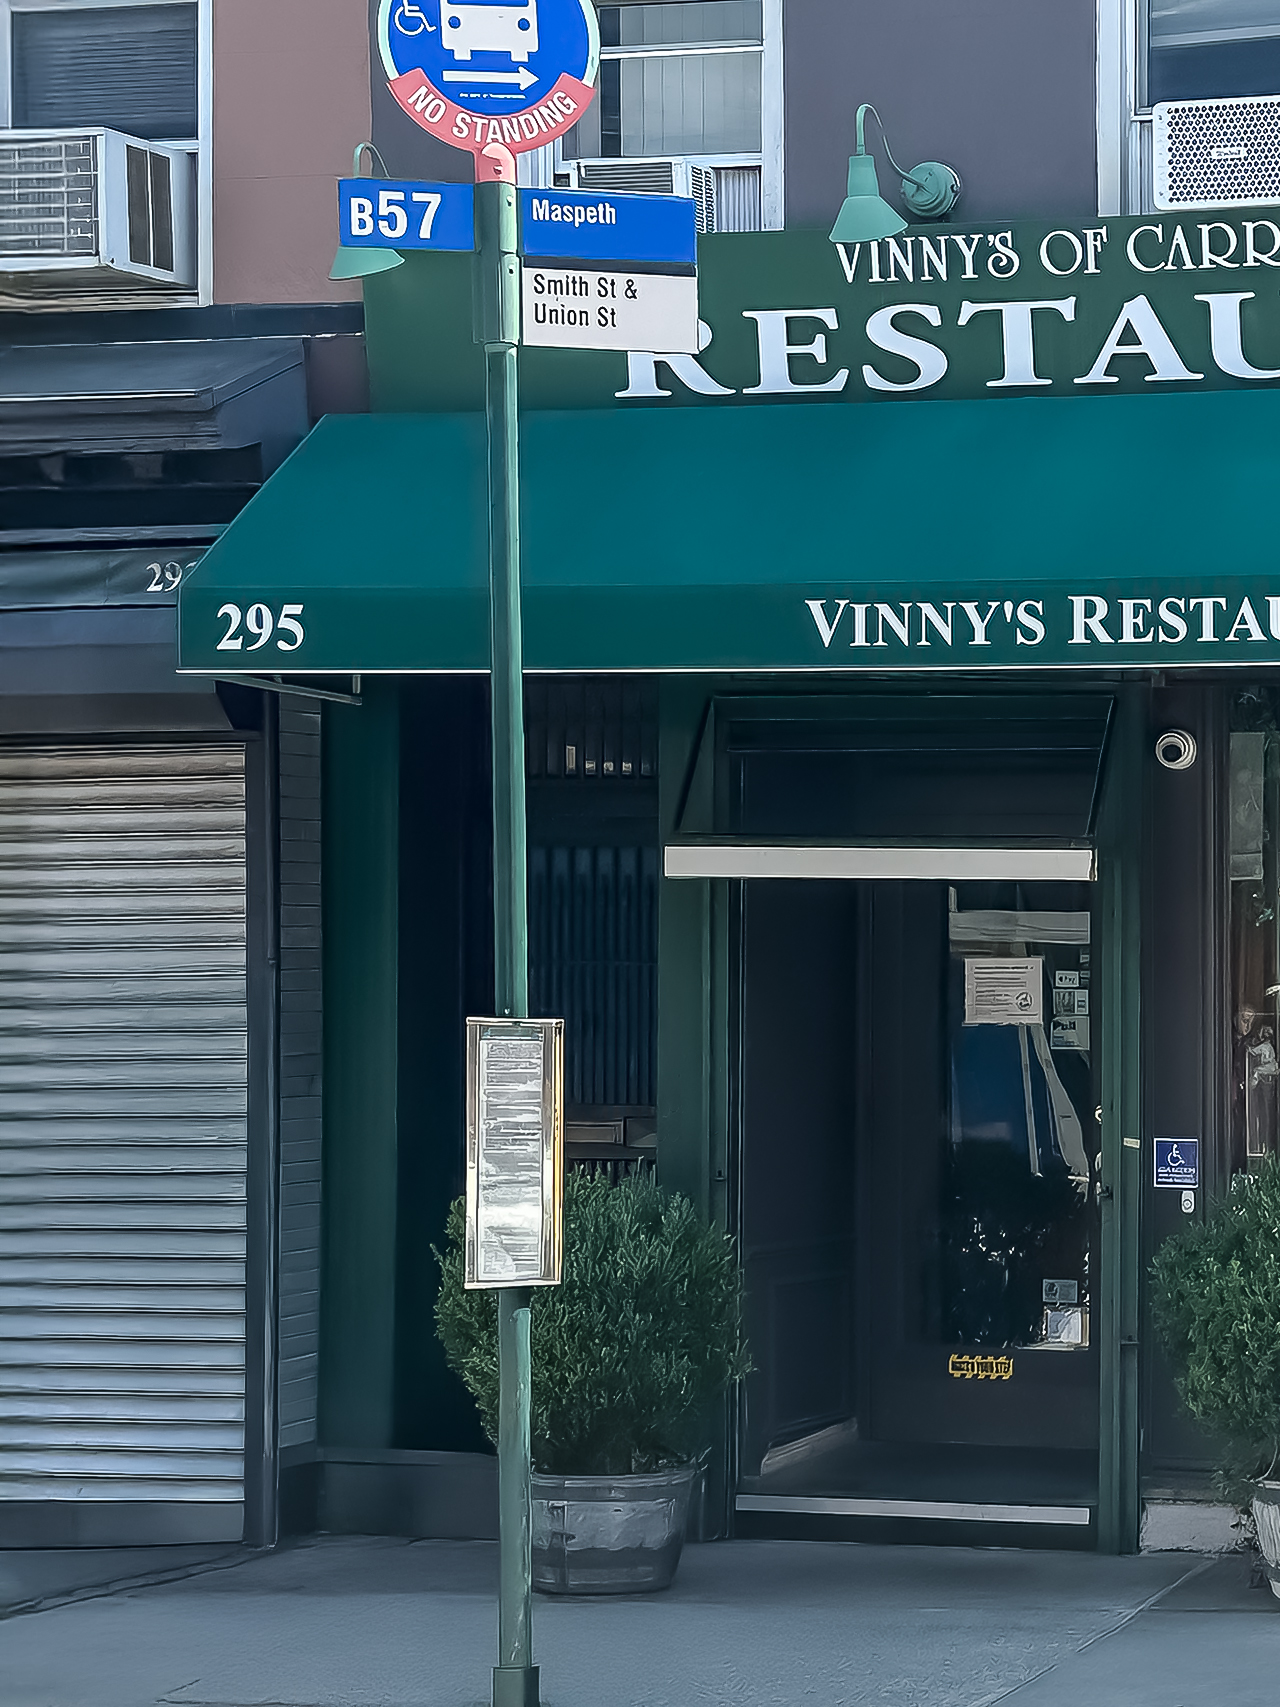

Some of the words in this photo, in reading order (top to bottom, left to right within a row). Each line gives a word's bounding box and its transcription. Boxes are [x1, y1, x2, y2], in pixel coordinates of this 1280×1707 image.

[406, 85, 446, 125] NO
[452, 91, 579, 144] STANDING
[350, 190, 442, 240] B57
[531, 199, 617, 226] Maspeth
[835, 229, 1020, 284] VINNY'S
[1039, 225, 1109, 276] OF
[533, 273, 589, 298] Smith
[597, 276, 617, 299] St
[624, 279, 639, 300] &
[534, 303, 590, 328] Union
[597, 305, 617, 329] St
[145, 561, 197, 592] 29
[216, 603, 305, 651] 295
[804, 598, 1047, 649] VINNY'S
